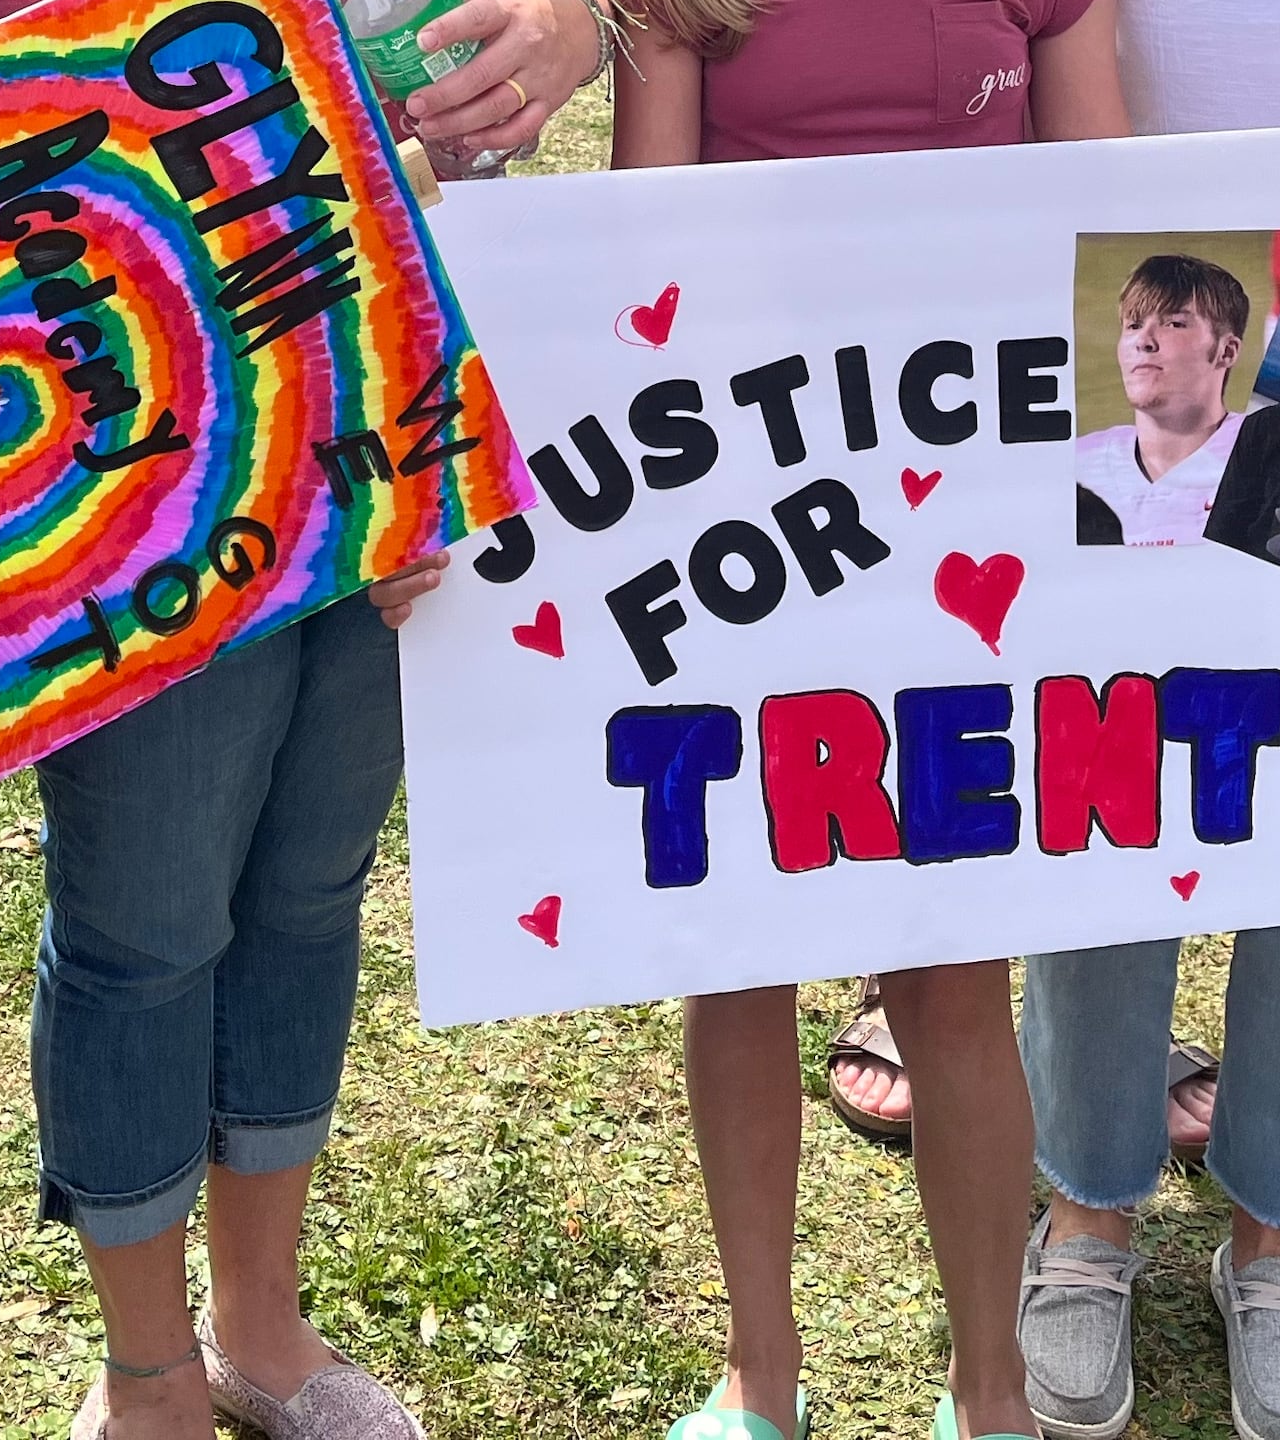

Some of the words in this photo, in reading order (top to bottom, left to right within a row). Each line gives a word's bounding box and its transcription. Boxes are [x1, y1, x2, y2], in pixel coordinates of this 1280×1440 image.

[125, 0, 362, 360] GLYNN
[472, 336, 1072, 584] JUSTICE
[29, 516, 277, 674] GOT
[604, 478, 892, 687] FOR
